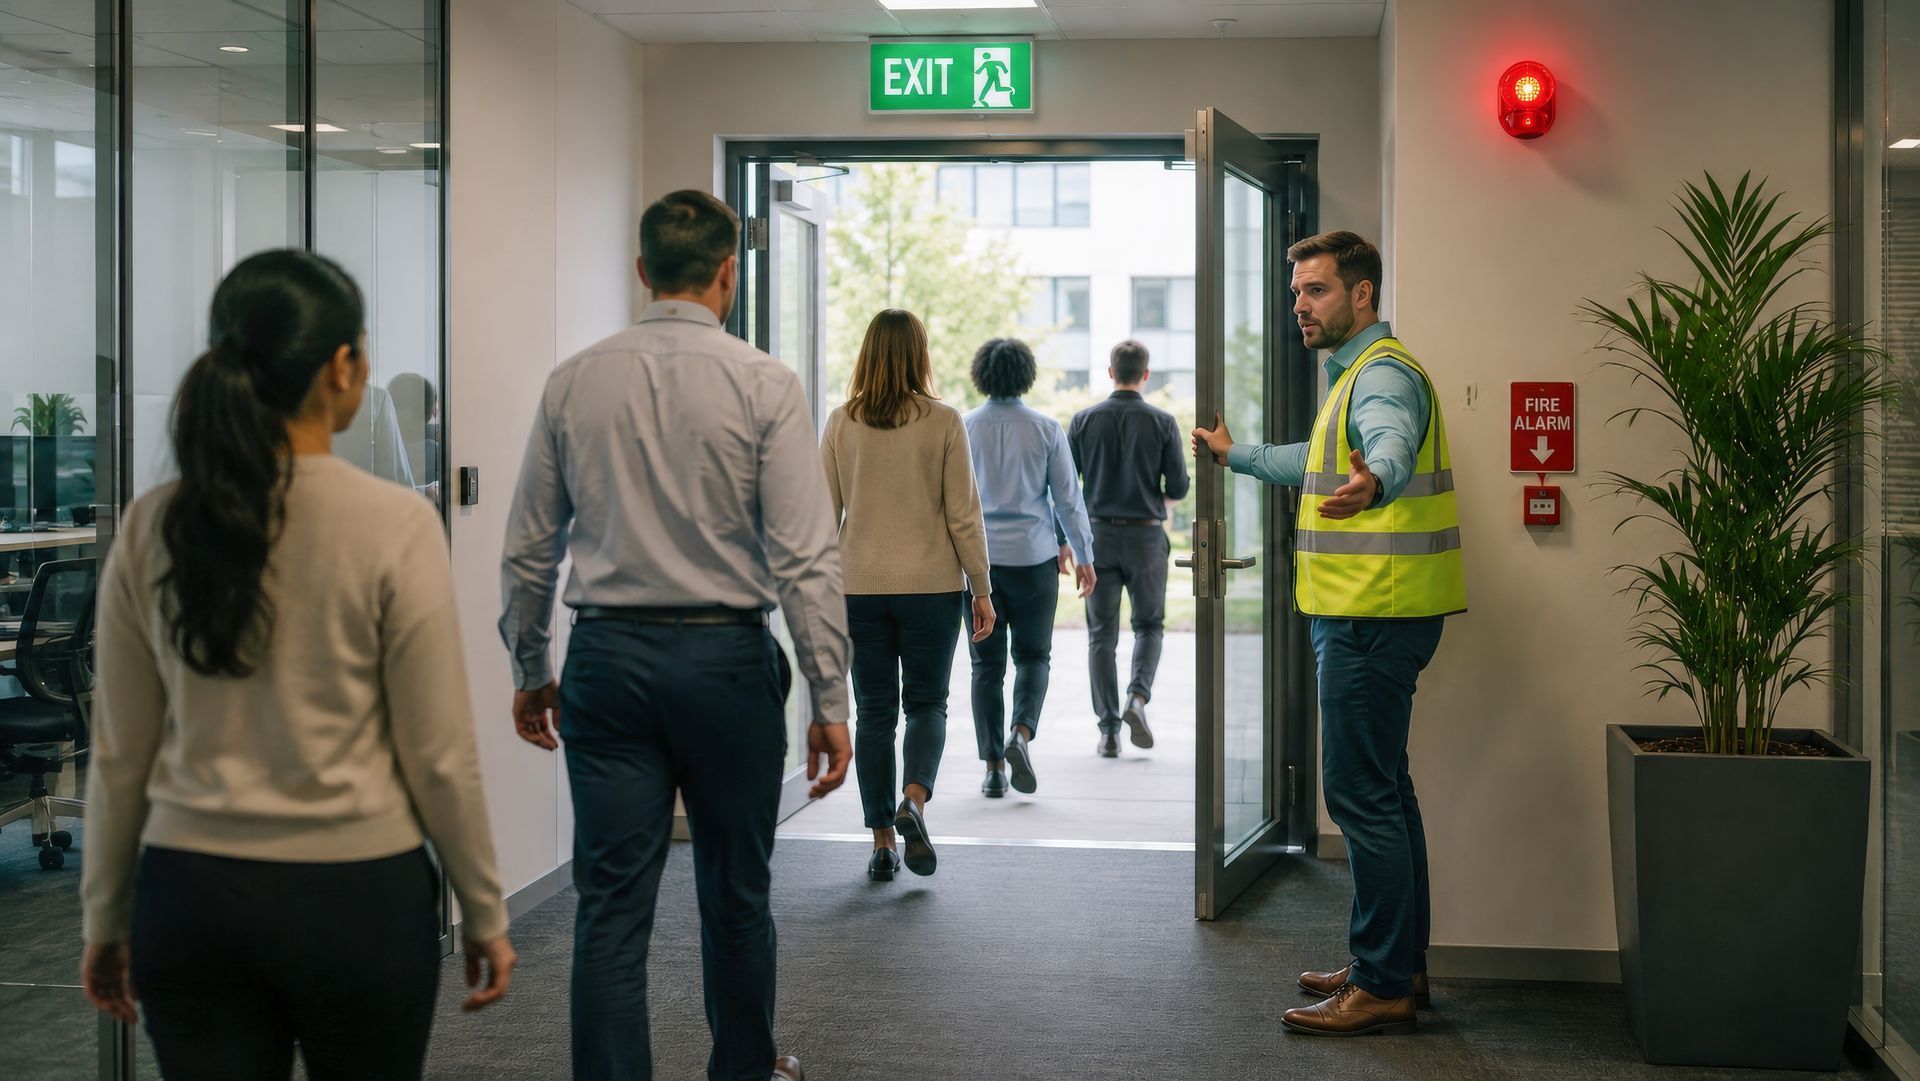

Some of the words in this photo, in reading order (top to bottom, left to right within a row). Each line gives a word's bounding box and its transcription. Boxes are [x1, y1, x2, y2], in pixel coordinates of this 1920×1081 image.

[884, 58, 953, 95] EXIT
[1525, 398, 1560, 412] FIRE
[1514, 416, 1570, 430] ALARM
